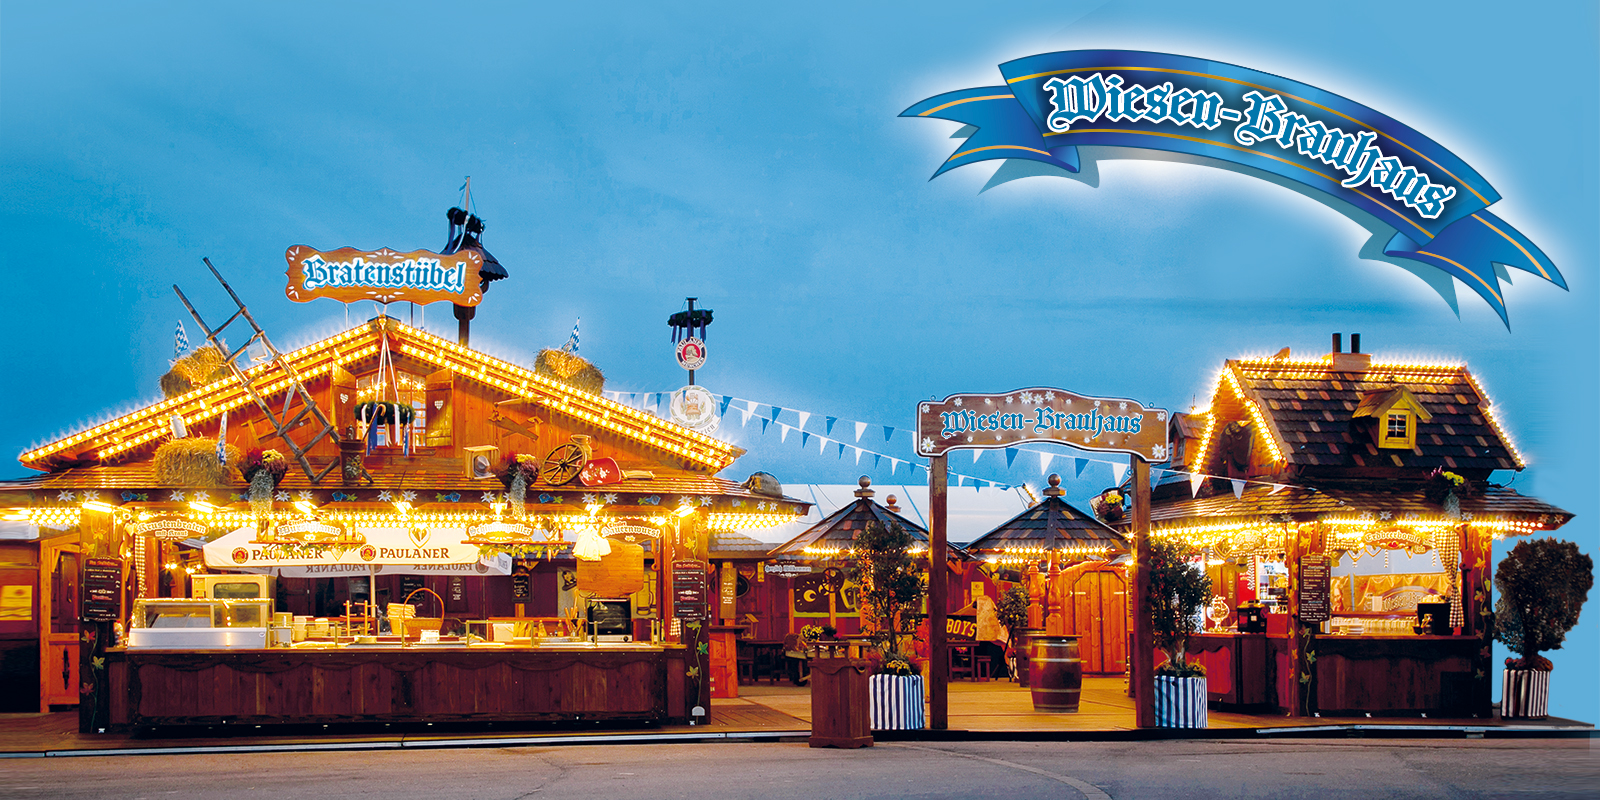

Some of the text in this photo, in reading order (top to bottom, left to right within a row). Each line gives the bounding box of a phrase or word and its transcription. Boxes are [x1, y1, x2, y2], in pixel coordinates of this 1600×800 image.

[301, 253, 466, 293] Bratenstübel
[677, 337, 704, 353] PAUANER
[940, 406, 1143, 439] Wiesen-Brauhaus
[137, 519, 206, 534] Krustenbraten
[379, 547, 450, 559] PAULANER
[946, 618, 978, 637] BOYS
